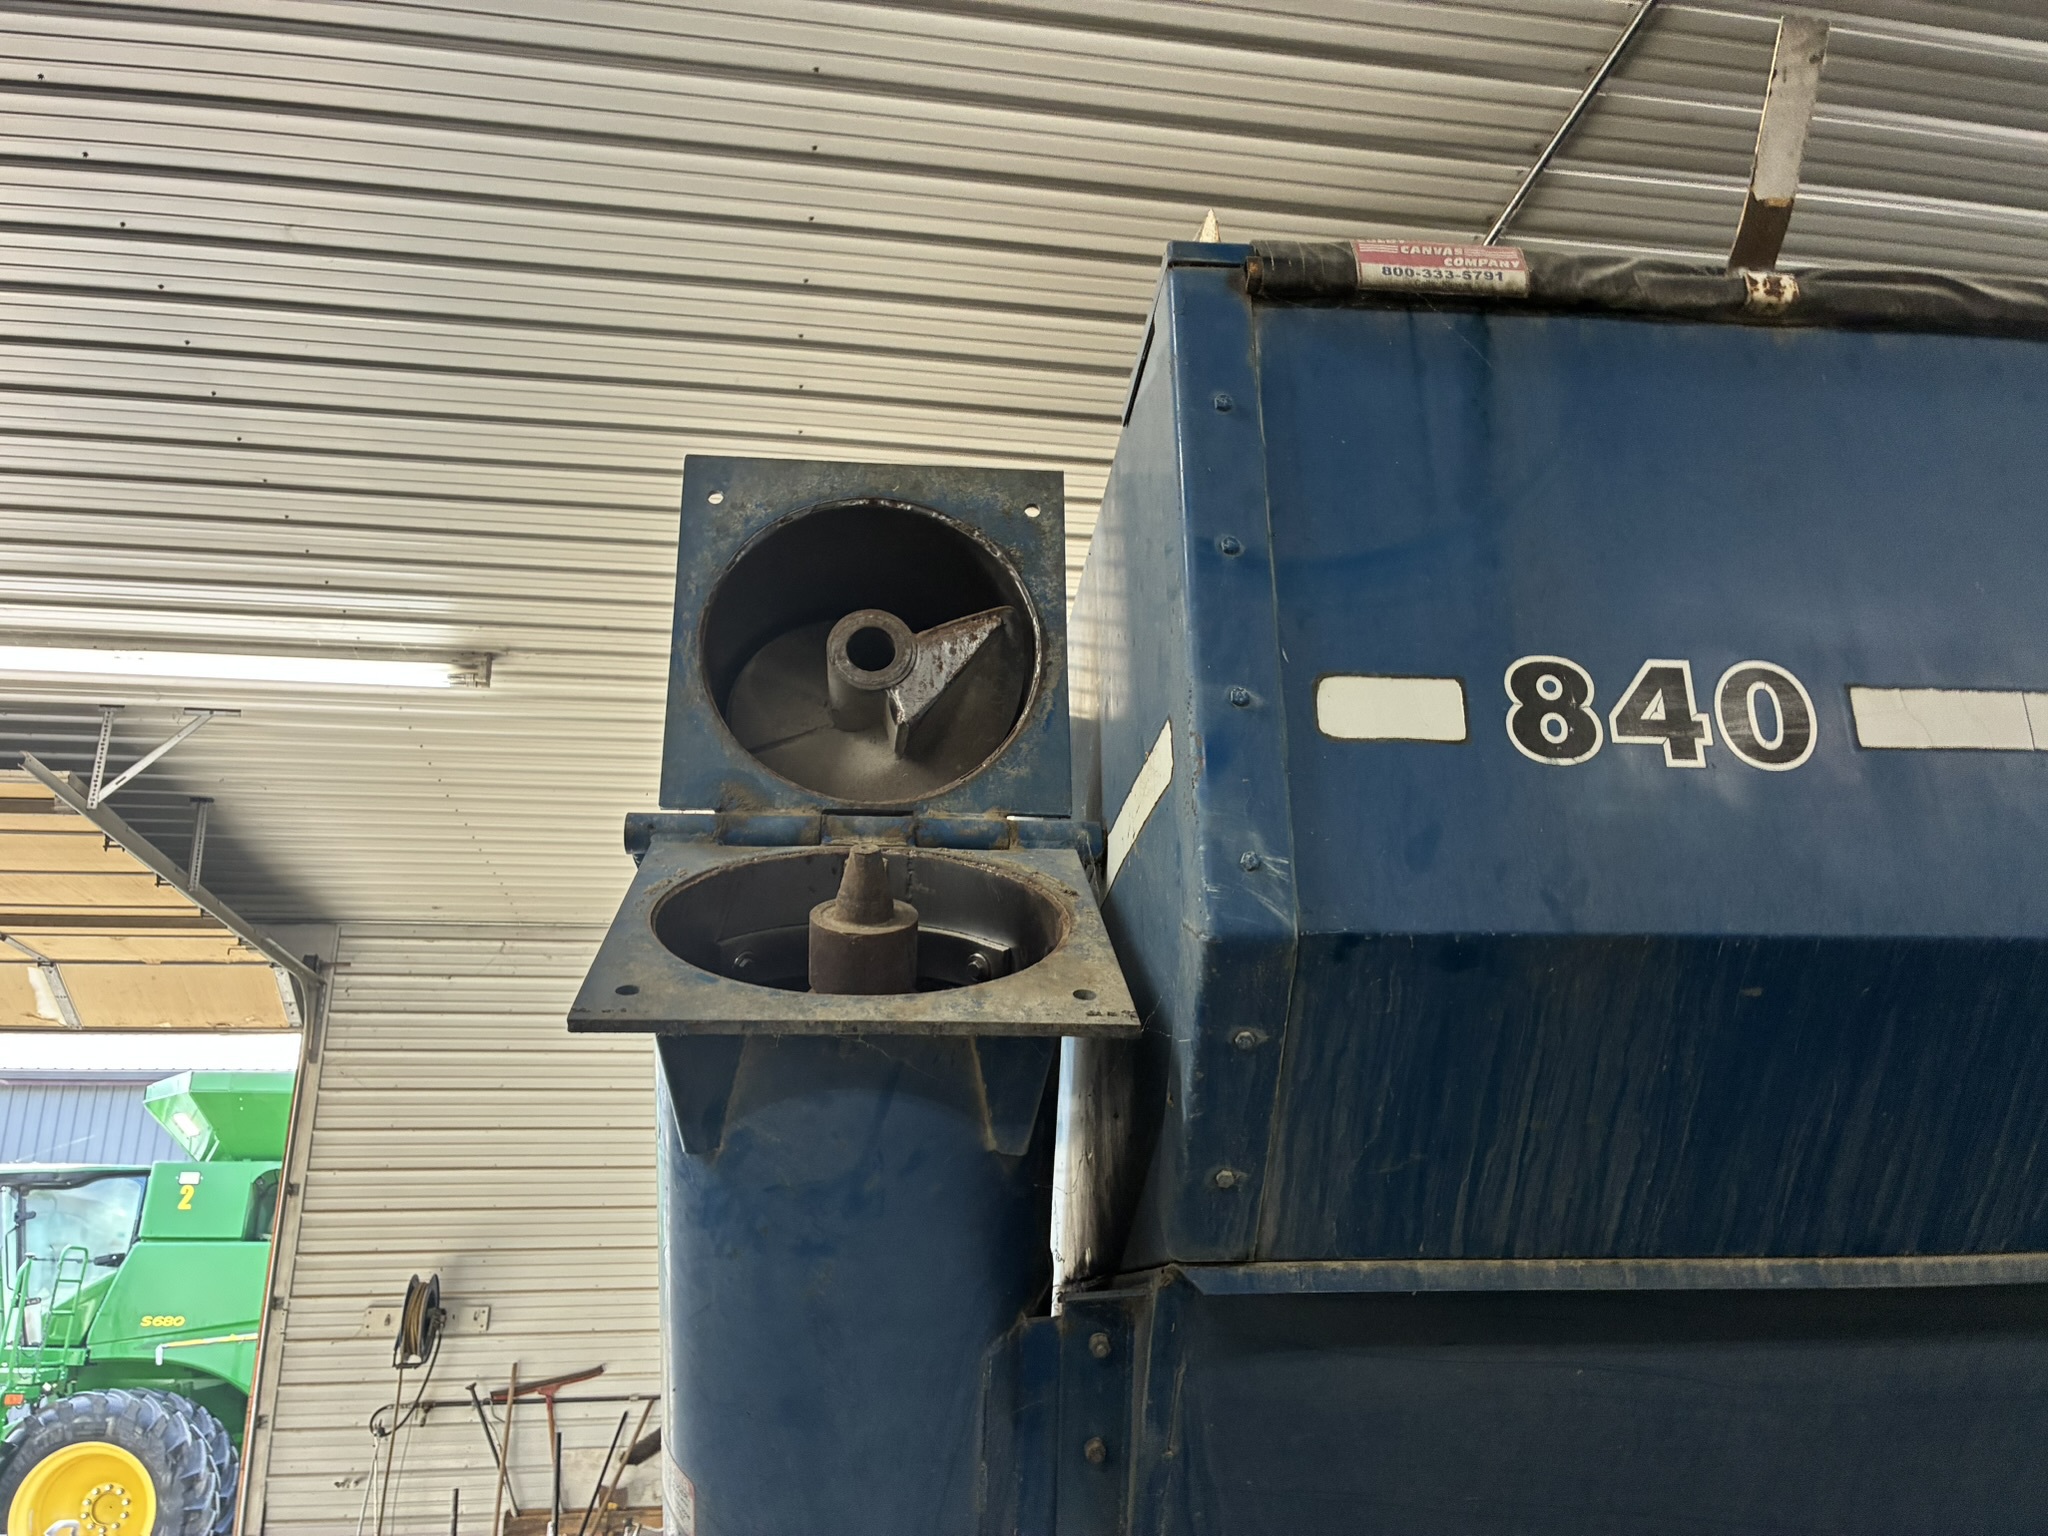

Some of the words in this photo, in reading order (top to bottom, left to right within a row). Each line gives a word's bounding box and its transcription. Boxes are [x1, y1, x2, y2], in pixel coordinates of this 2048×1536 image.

[1401, 245, 1463, 256] CANVAS
[1444, 257, 1520, 268] COMPANY
[1382, 266, 1503, 281] 800-333-5791
[1504, 655, 1818, 772] 840
[177, 1184, 194, 1210] 2
[140, 1315, 186, 1327] S680
